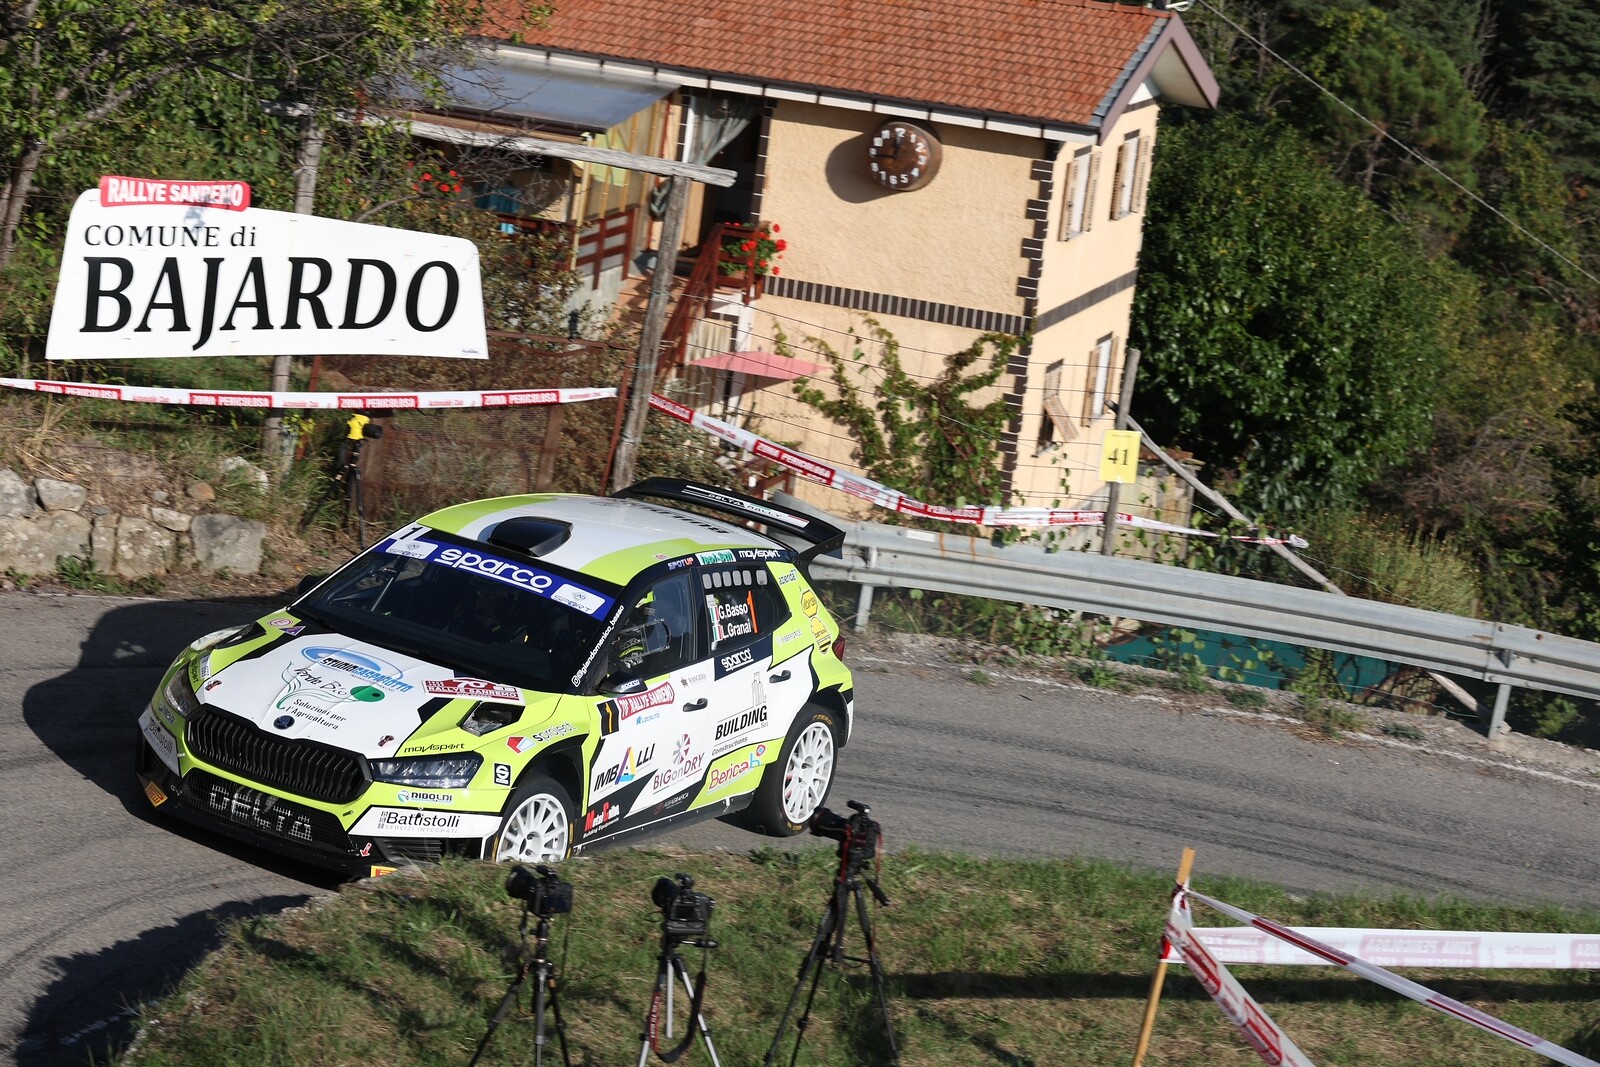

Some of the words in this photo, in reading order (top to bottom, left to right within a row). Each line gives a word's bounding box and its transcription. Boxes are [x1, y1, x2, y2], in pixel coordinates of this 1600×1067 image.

[915, 142, 925, 152] 2
[889, 175, 898, 185] 6
[900, 174, 909, 183] 5
[107, 177, 168, 203] RALLYE
[84, 224, 221, 247] COMUNE
[230, 225, 257, 247] di
[79, 255, 460, 351] BAJARDO
[484, 394, 507, 406] ZONA
[1107, 447, 1129, 466] 41
[399, 526, 424, 541] 1
[440, 548, 553, 590] sparco
[719, 603, 749, 620] G.Basso
[747, 591, 758, 634] 1
[723, 618, 752, 639] L.Granai
[721, 648, 753, 671] sparco
[472, 688, 519, 698] SANREMO
[628, 691, 650, 715] RALLYE
[648, 684, 673, 706] SANREMO
[329, 713, 347, 722] per
[605, 702, 613, 734] 1
[715, 705, 768, 741] BUILDING
[711, 736, 748, 756] Constructions
[593, 743, 656, 793] IMBALLI
[652, 752, 706, 791] BIGonDRY
[411, 791, 453, 802] RIBOLDI
[209, 784, 313, 842] DELTA
[386, 811, 461, 828] Battistolli
[384, 824, 414, 832] SERVIZI
[417, 826, 458, 834] INTEGRATI
